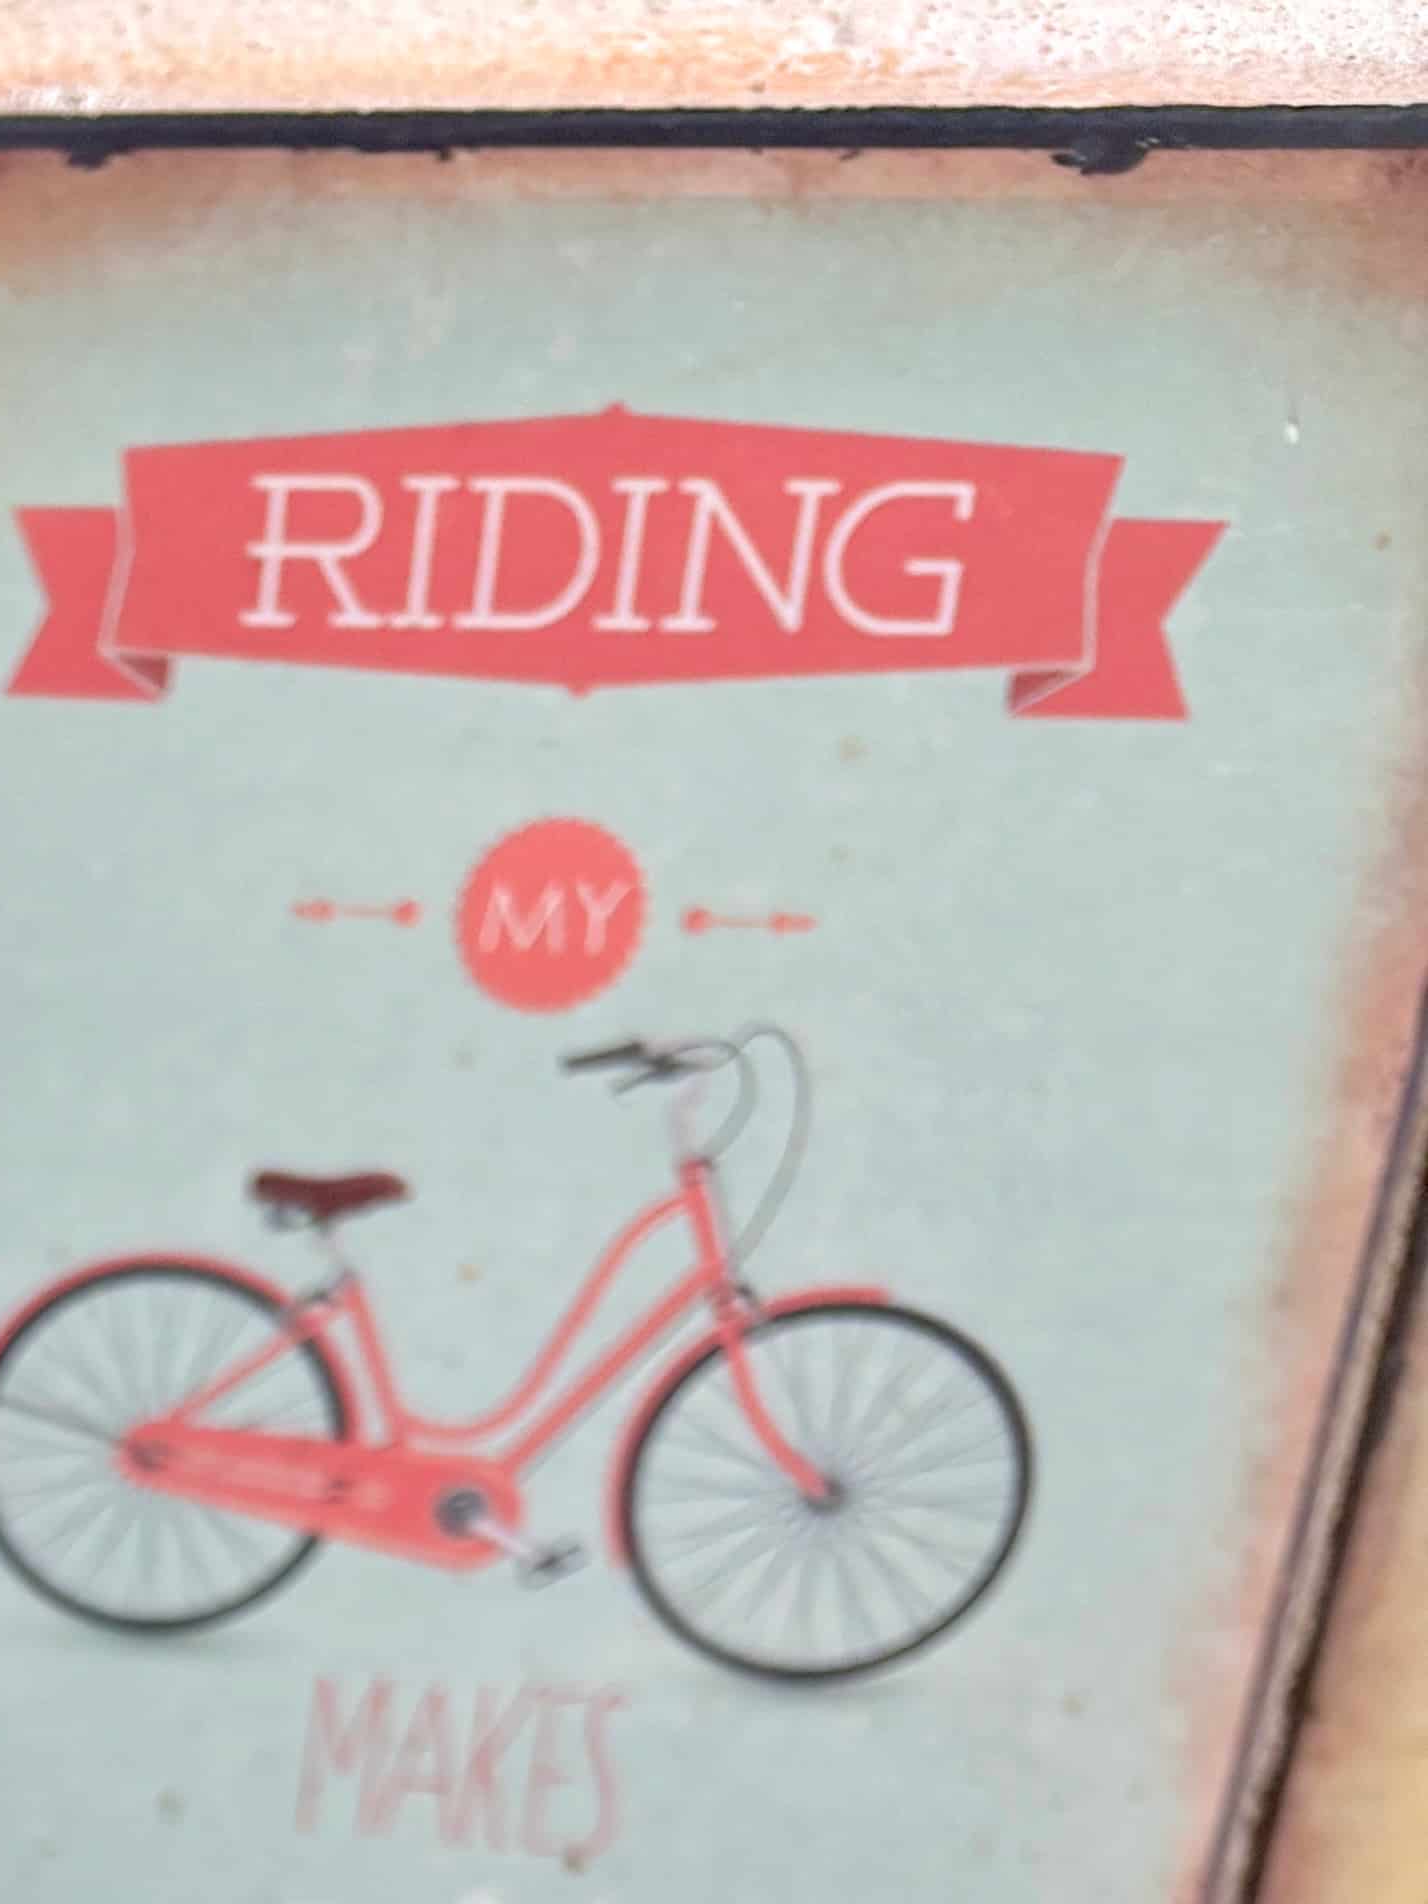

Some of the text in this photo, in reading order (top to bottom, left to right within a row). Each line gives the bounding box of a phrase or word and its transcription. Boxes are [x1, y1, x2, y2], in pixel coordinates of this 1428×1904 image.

[240, 474, 976, 634] RIDING
[479, 880, 629, 950] MY
[294, 1676, 632, 1864] MAKES
